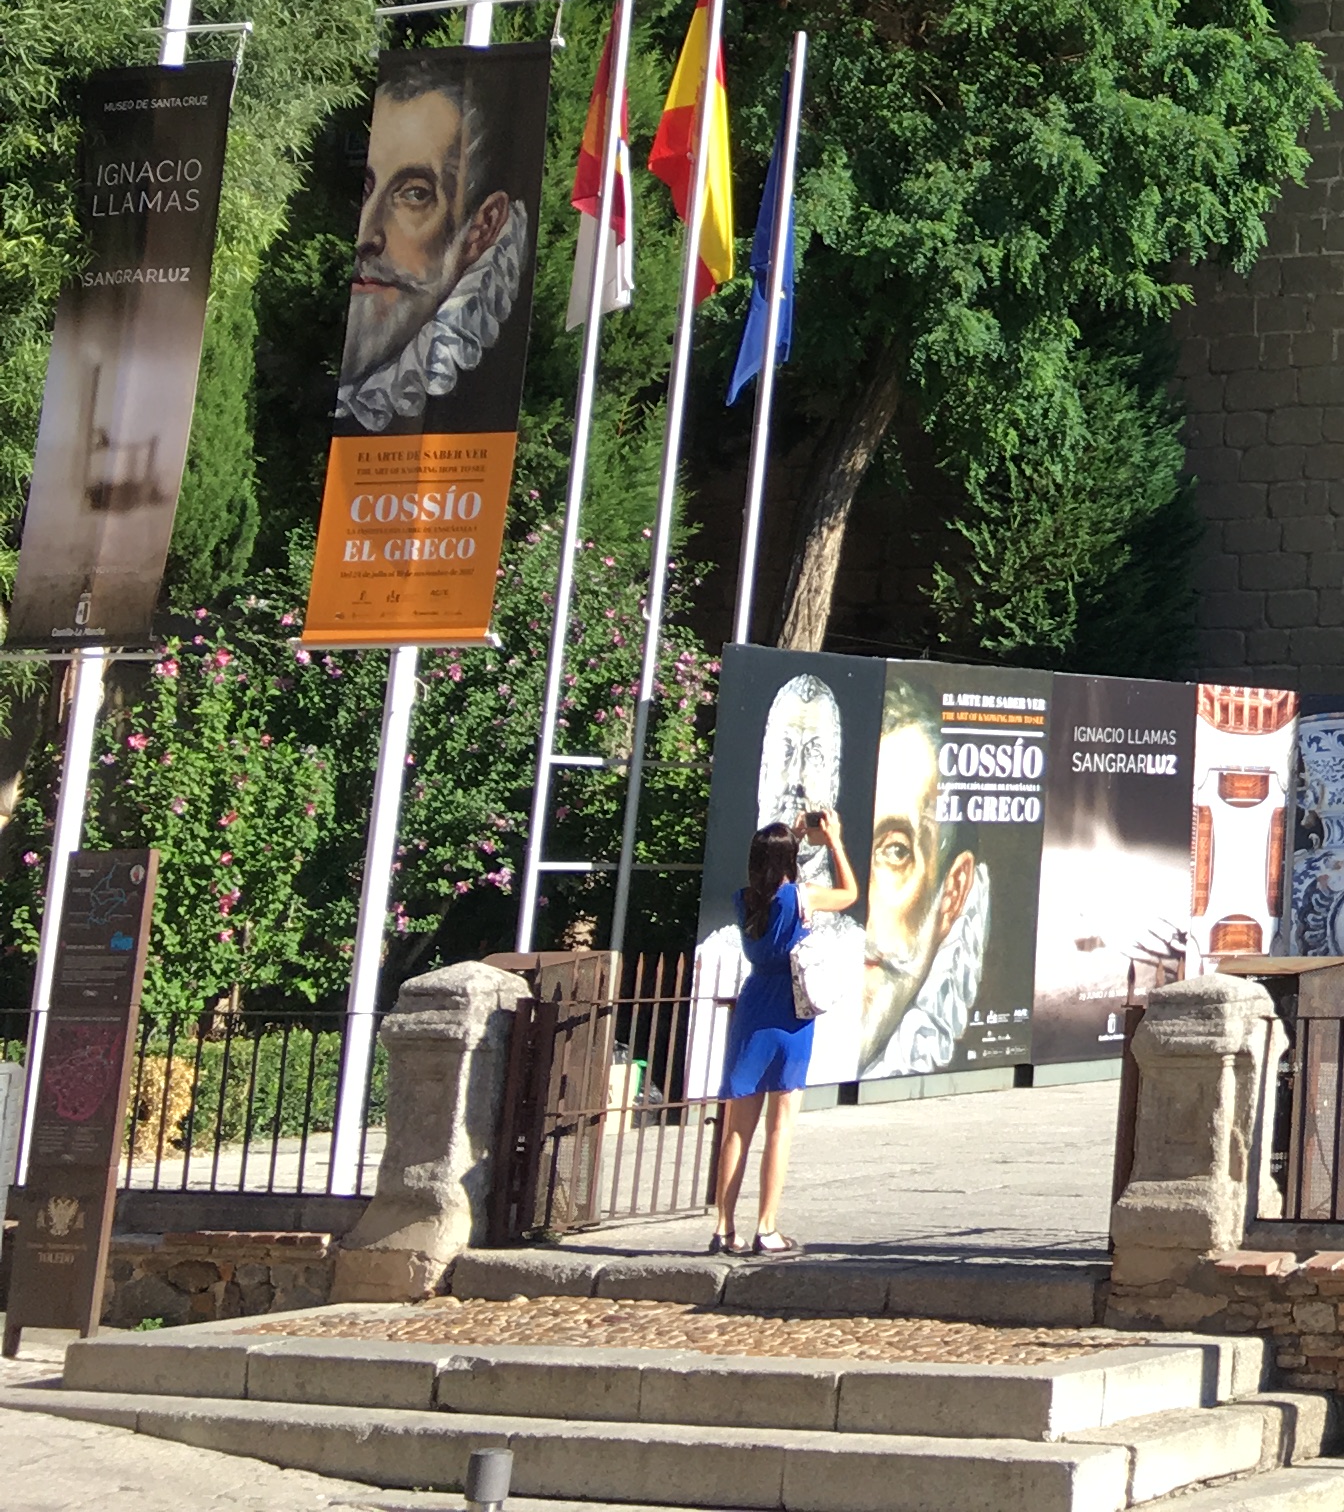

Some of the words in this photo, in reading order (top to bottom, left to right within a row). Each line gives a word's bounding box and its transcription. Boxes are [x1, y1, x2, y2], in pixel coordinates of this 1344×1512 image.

[104, 100, 134, 112] MUSEO
[135, 99, 149, 109] DE
[150, 97, 182, 109] SANTA
[182, 95, 209, 106] CRUZ
[97, 158, 203, 186] IGNACIO
[92, 189, 200, 216] LLAMAS
[84, 267, 191, 287] SANGRARLUZ
[357, 452, 371, 462] EL
[377, 451, 403, 461] ARTE
[406, 450, 421, 461] DE
[424, 449, 462, 460] SABER
[463, 449, 488, 459] VER
[350, 485, 483, 523] COSSÍO
[342, 540, 376, 562] EL
[383, 537, 476, 561] GRECO
[942, 693, 955, 706] EL
[956, 693, 981, 707] ARTE
[982, 695, 995, 708] DE
[996, 696, 1026, 709] SABER
[1026, 697, 1046, 710] VER
[1073, 726, 1125, 743] IGNACIO
[1127, 728, 1177, 745] LLAMAS
[938, 737, 1044, 779] COSSÍO
[1072, 751, 1178, 775] SANGRARLUZ
[967, 795, 1041, 822] GRECO
